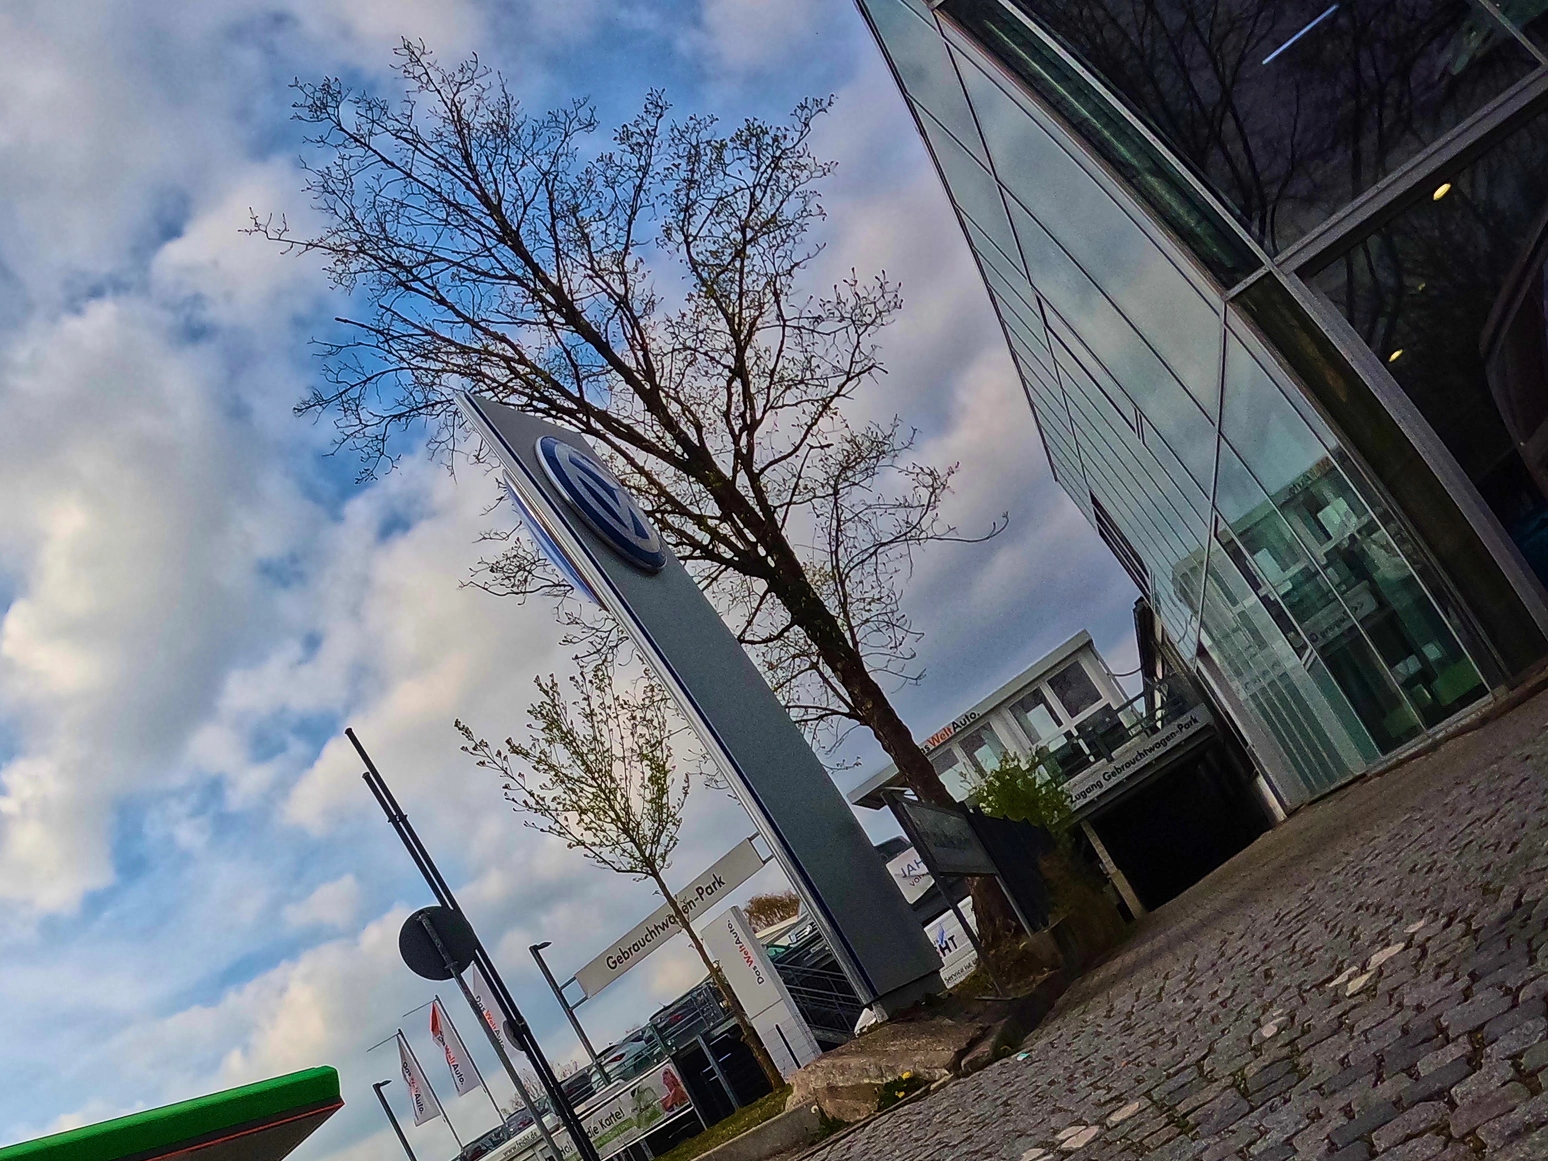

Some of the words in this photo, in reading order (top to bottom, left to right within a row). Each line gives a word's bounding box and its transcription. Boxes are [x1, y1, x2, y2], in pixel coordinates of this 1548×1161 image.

[1068, 779, 1104, 803] Zugang
[1102, 715, 1199, 782] Gebrauchtwagen-Park
[606, 873, 726, 970] Gebrauchtwaen-Park
[752, 965, 765, 985] Das
